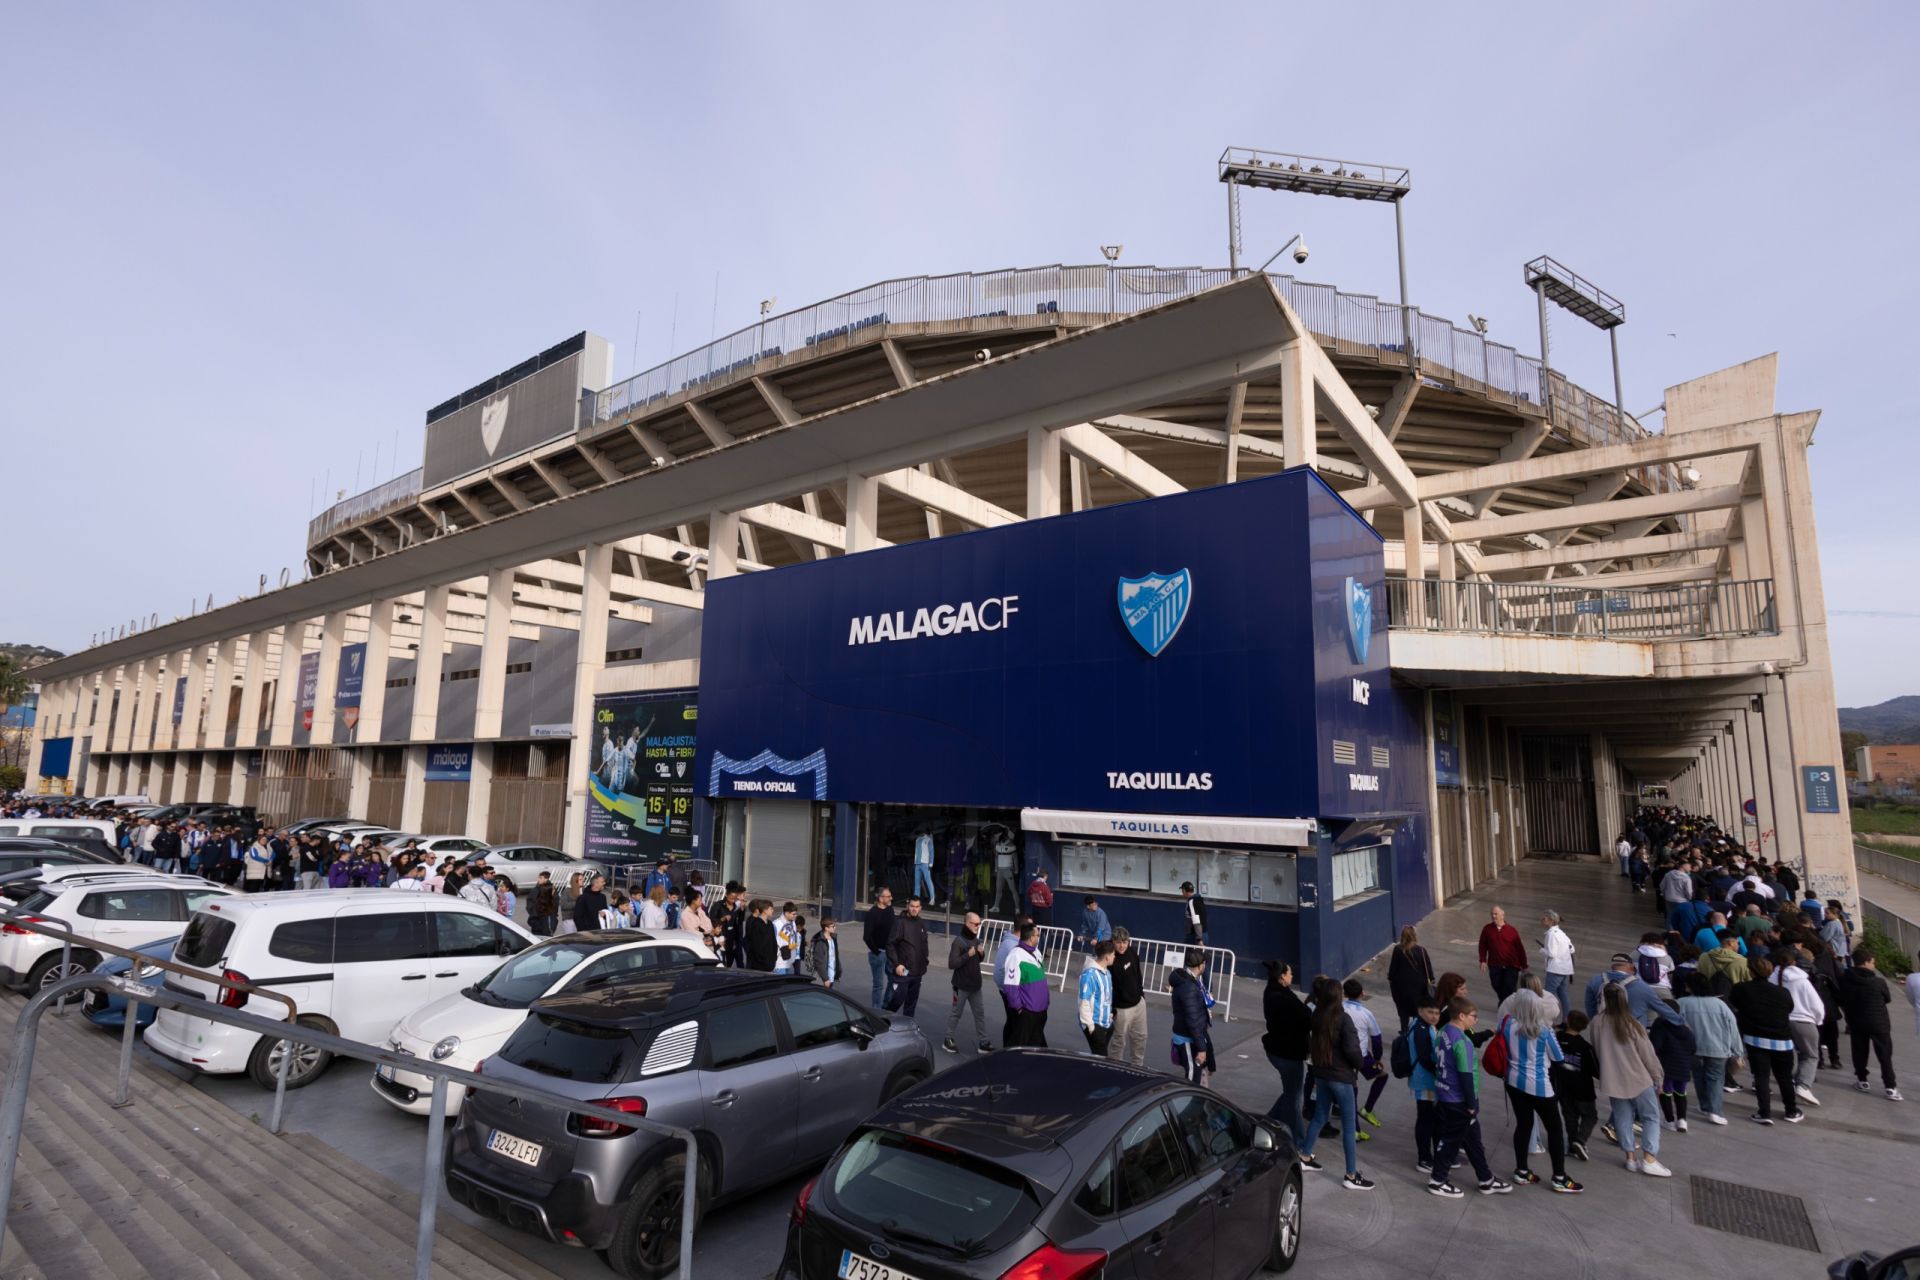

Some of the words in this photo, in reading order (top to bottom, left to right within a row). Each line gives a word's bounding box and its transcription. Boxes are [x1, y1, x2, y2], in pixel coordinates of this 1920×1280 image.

[848, 595, 1019, 645] MALAGACF
[433, 747, 468, 769] málaga
[645, 748, 667, 758] HASTA
[1107, 772, 1213, 791] TAQUILLAS
[1349, 773, 1379, 792] TAQUILLAS
[1810, 771, 1830, 782] P3
[733, 781, 762, 791] TIENDA
[764, 781, 796, 793] OFICIAL
[1110, 820, 1190, 835] TAQUILLAS
[494, 1134, 518, 1156] 3242
[517, 1143, 539, 1163] LFD
